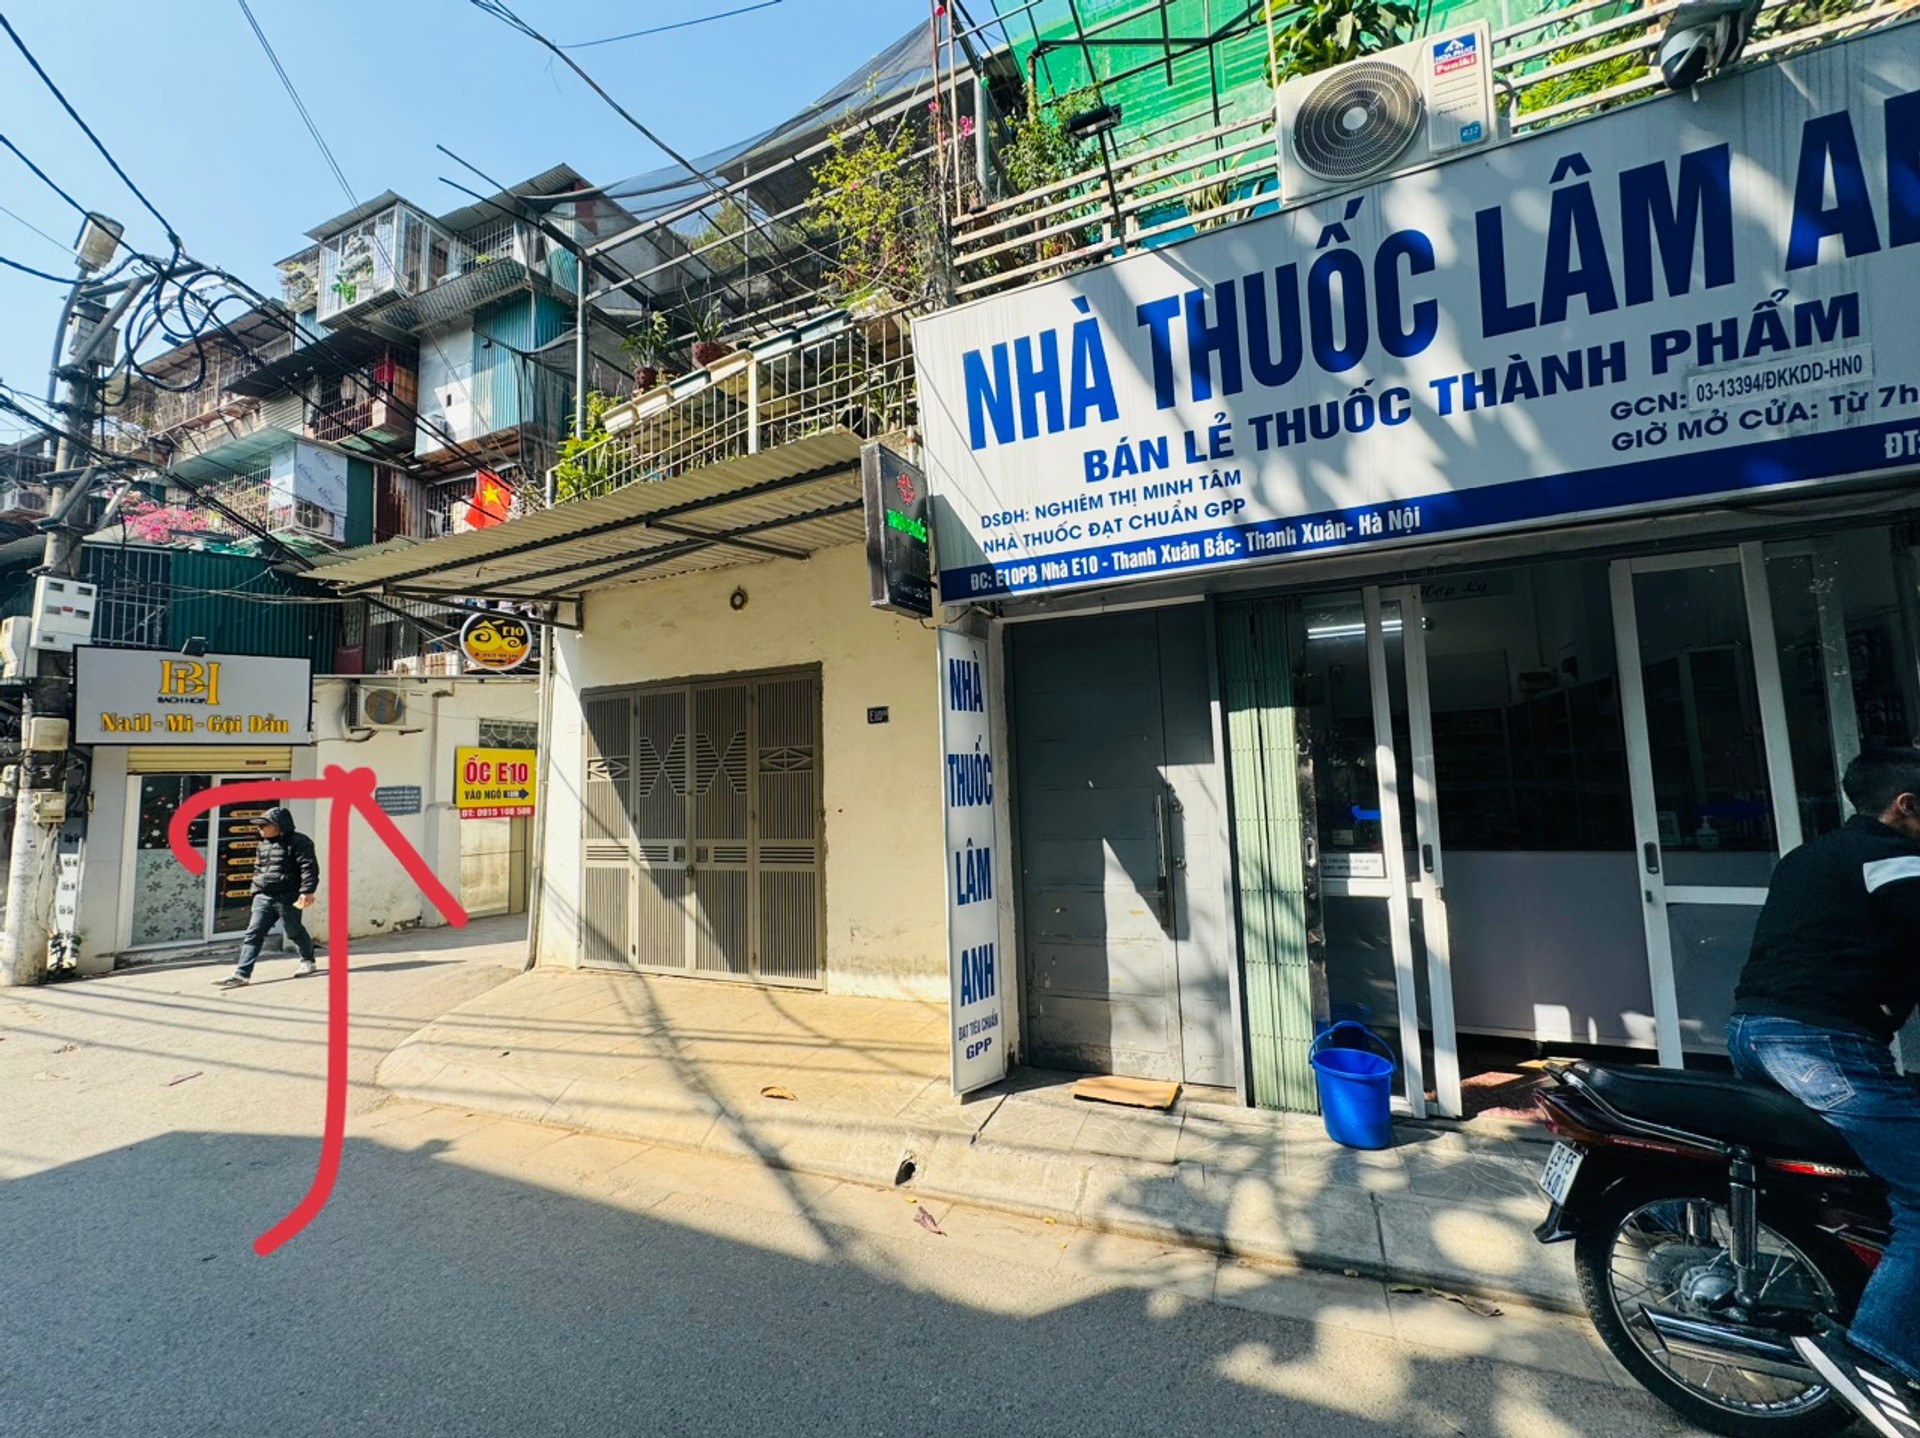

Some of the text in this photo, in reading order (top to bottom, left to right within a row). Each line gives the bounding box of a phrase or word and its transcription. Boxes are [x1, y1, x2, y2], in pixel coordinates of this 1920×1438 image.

[962, 296, 1119, 450] NHÀ
[1136, 196, 1439, 411] THUỐC
[1475, 142, 1736, 339] LÂM
[1083, 288, 1860, 484] BÁN LẺ THUỐC THÀNH PHẨM
[1610, 391, 1687, 421] GCN:
[1611, 383, 1920, 452] GIỜ MỞ CỬA: Từ 7h
[980, 469, 1242, 530] DSĐH: NGHIÊM THỊ MINH TÂM
[982, 498, 1246, 555] NHÀ THUỐC ĐẠT CHUẨN GPP
[970, 570, 992, 592] ĐC:
[996, 564, 1038, 587] E10PB
[1041, 558, 1069, 582] Nhà
[1071, 555, 1099, 578] E10
[1111, 547, 1157, 571] Thanh
[1160, 539, 1199, 565] Xuân
[1245, 526, 1297, 553] Thanh
[1358, 512, 1383, 537] Hà
[1387, 505, 1421, 535] Nội
[948, 650, 985, 714] NHÀ
[100, 711, 152, 733] Nail
[165, 714, 194, 733] Mi
[207, 714, 242, 736] Gội
[248, 713, 289, 733] Đầu
[464, 753, 529, 785] ỐC E10
[464, 788, 482, 801] VÀO
[947, 734, 993, 808] THUỐC
[955, 837, 992, 906] LÂM
[960, 943, 996, 1007] ANH
[966, 1037, 992, 1059] GPP
[1812, 1163, 1870, 1178] HONDA
